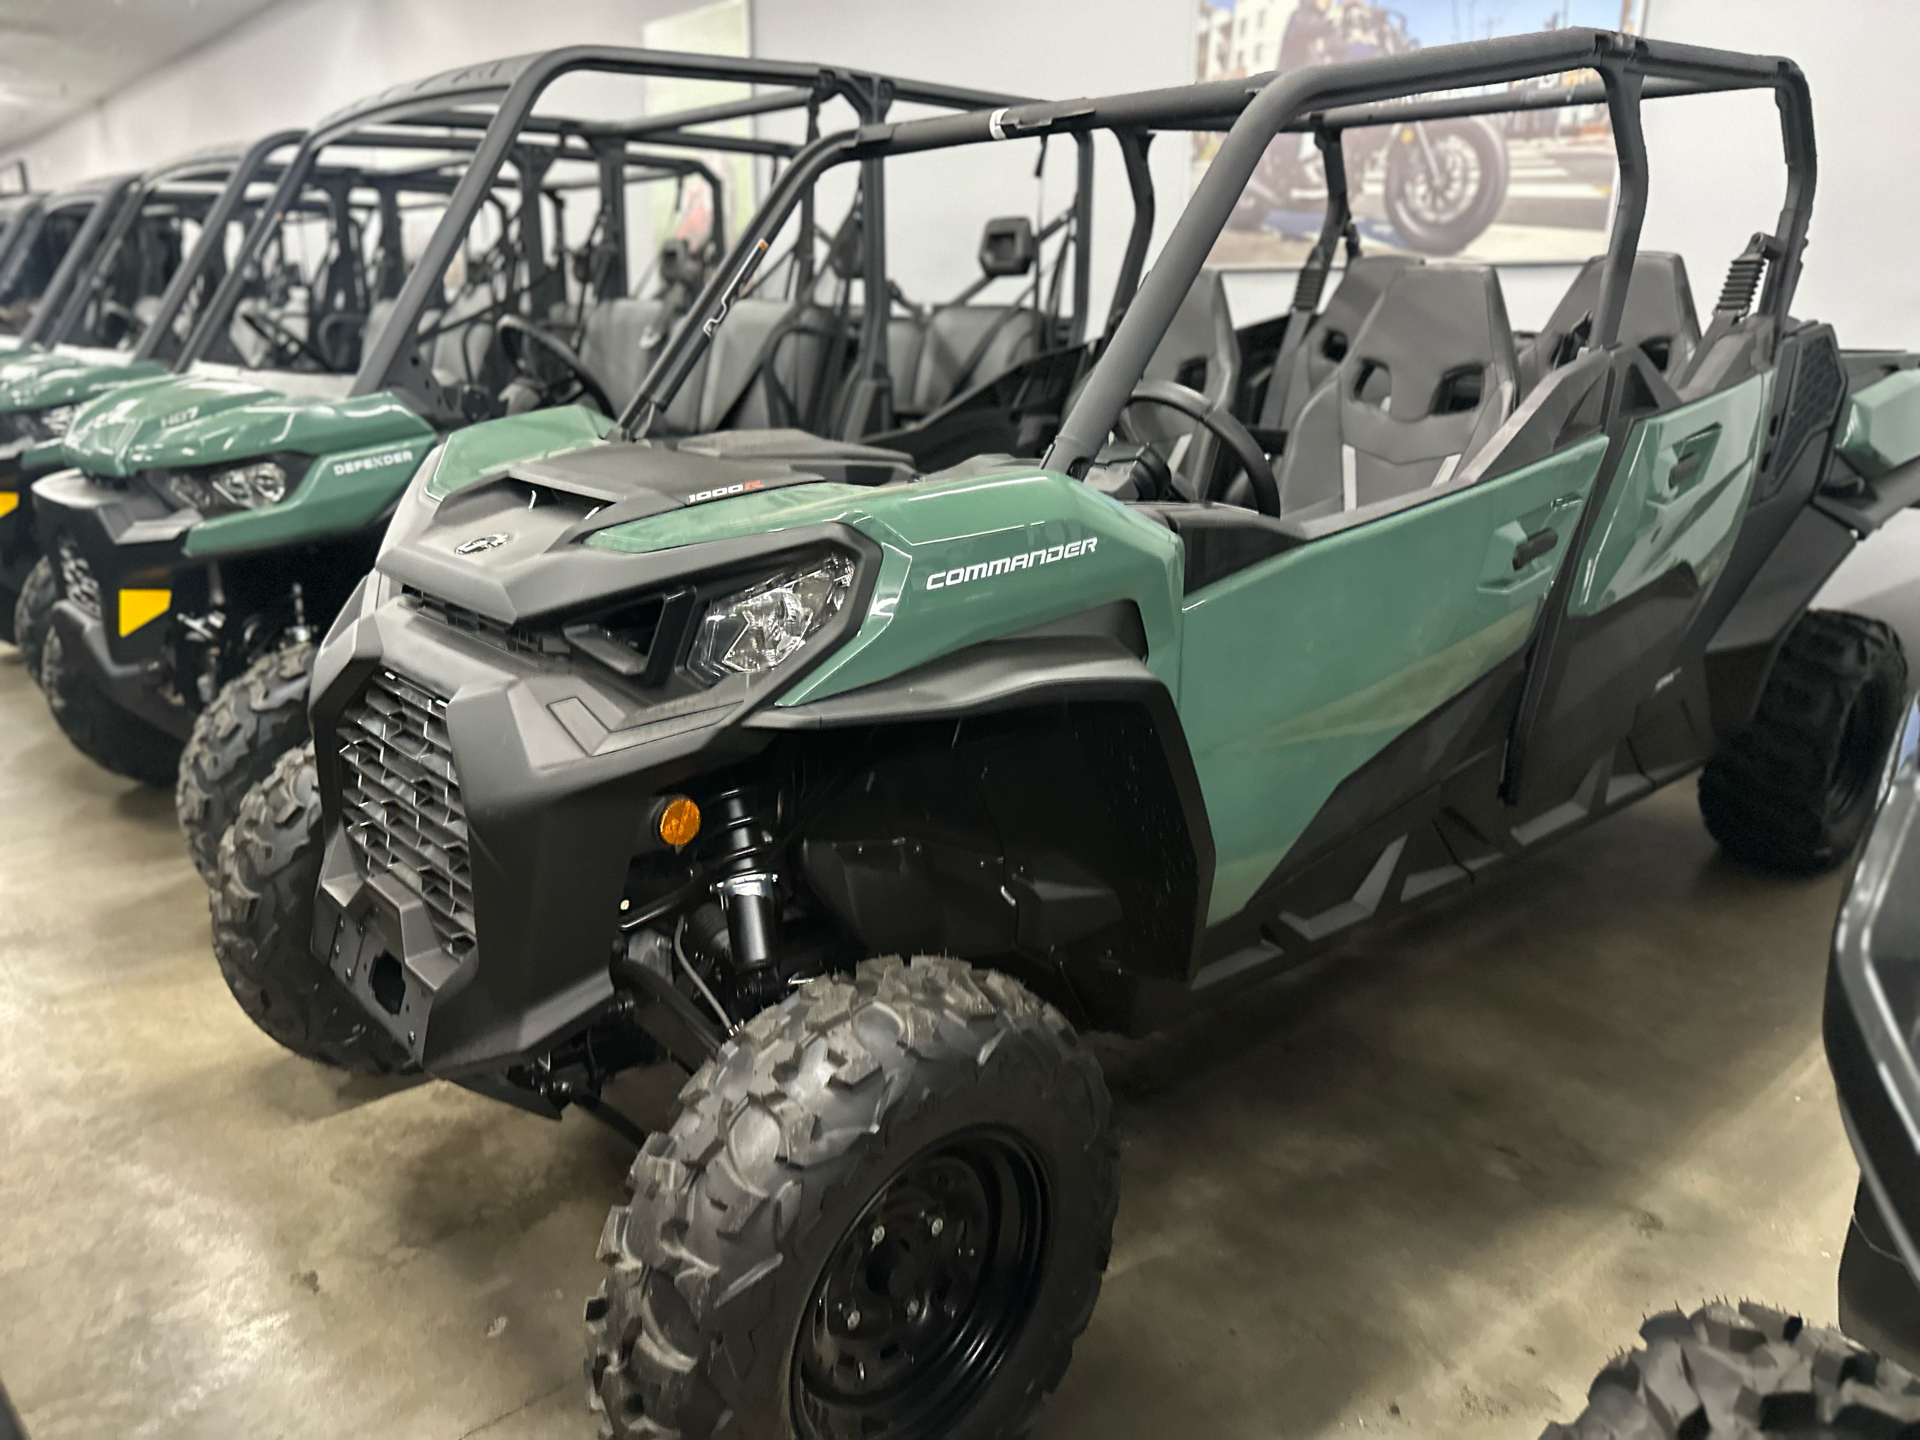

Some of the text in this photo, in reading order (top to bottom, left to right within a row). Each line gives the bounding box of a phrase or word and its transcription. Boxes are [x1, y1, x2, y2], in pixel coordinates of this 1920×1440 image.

[333, 450, 413, 476] DEFENDER
[689, 481, 762, 503] 1000R
[926, 537, 1098, 591] COMMANDER
